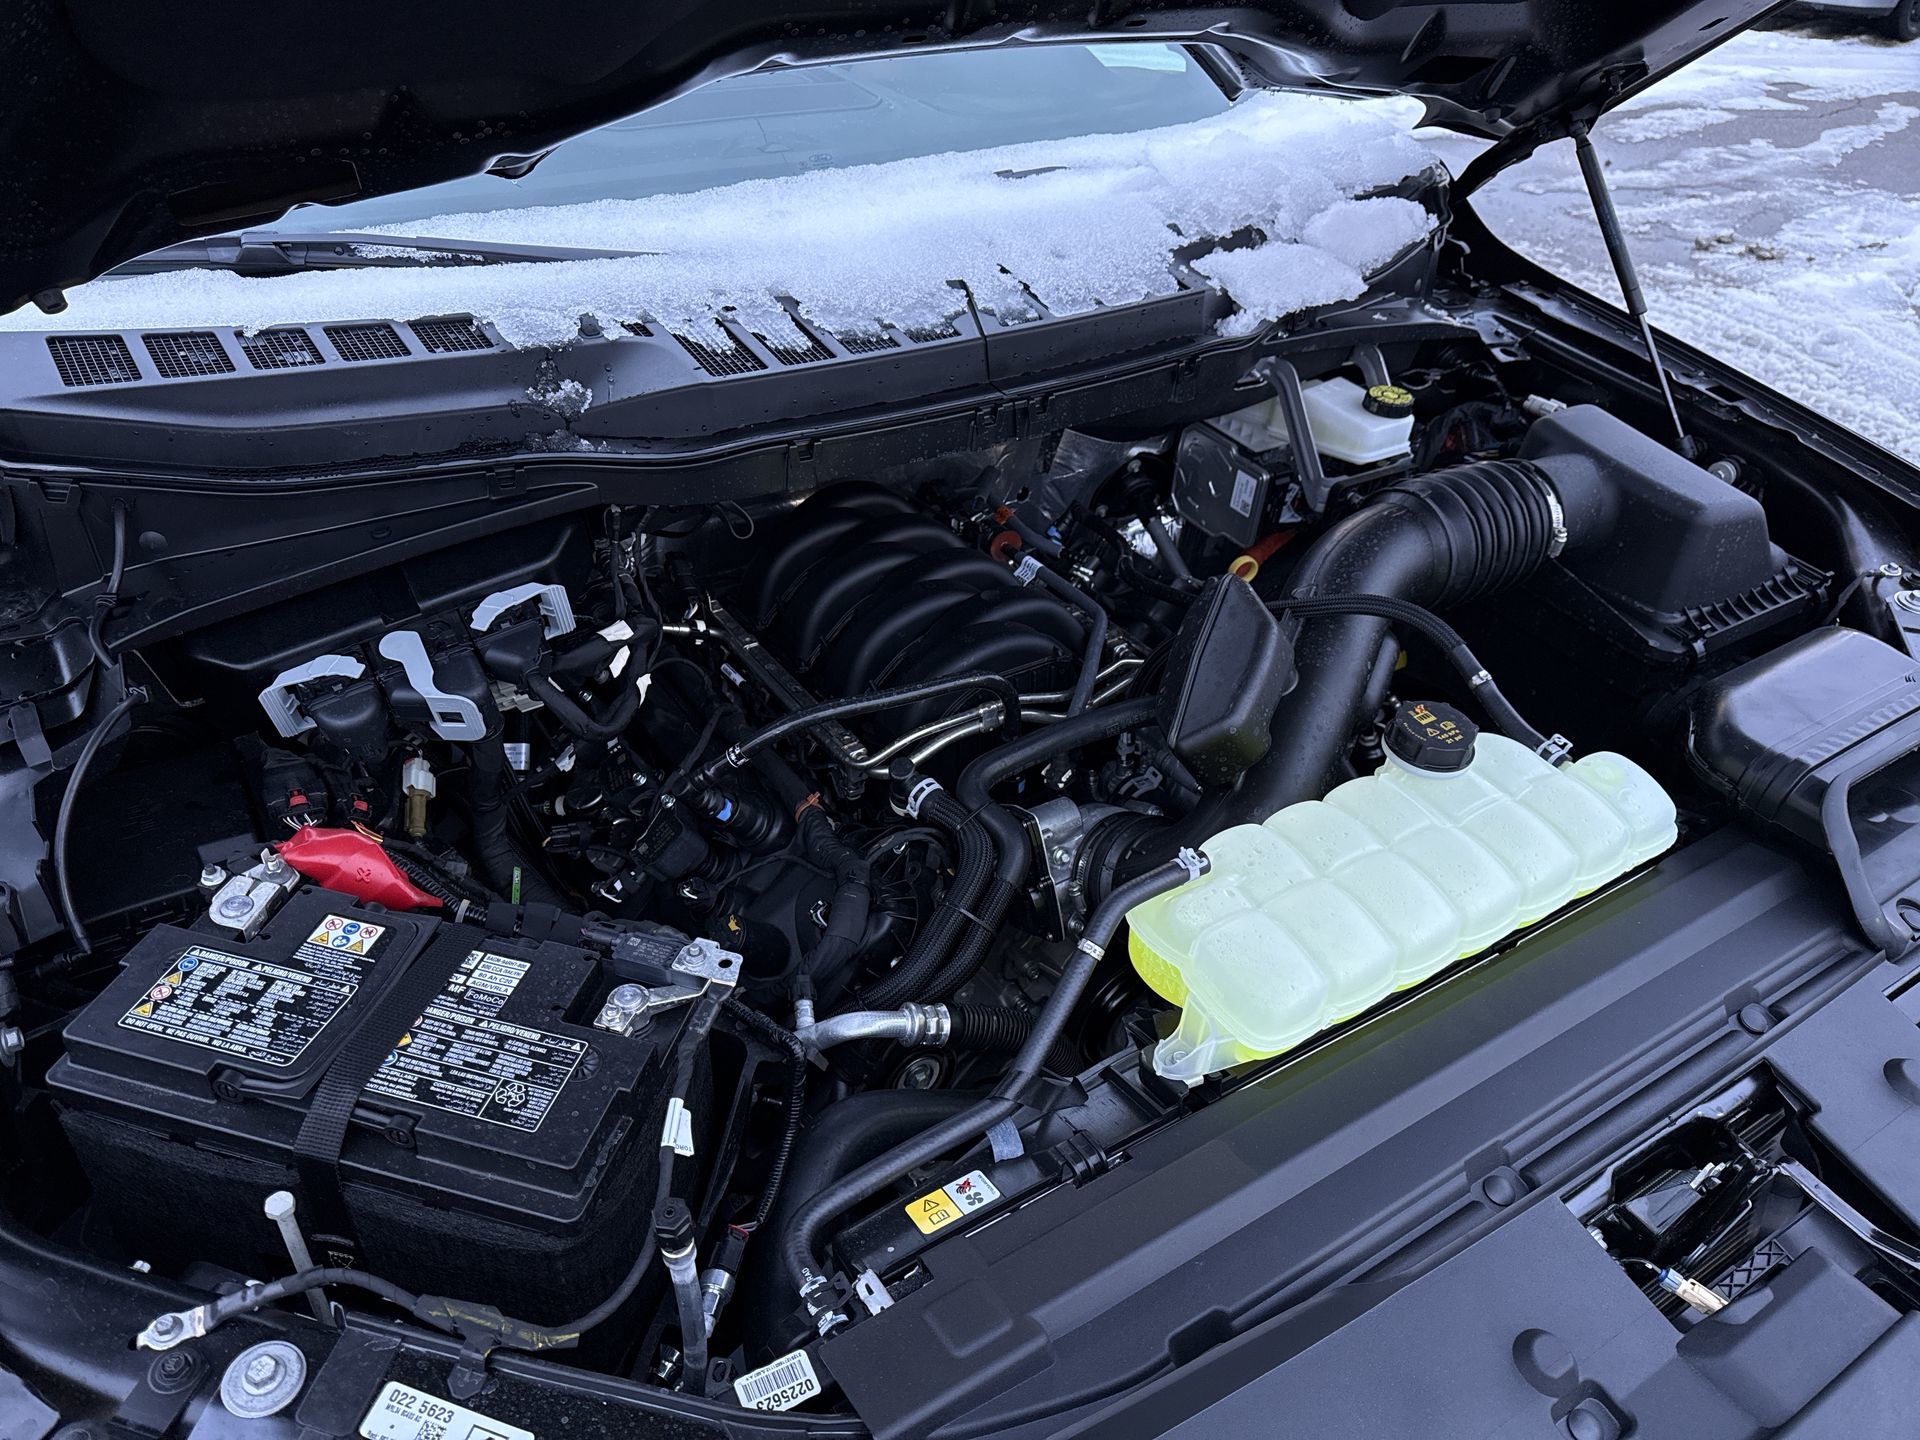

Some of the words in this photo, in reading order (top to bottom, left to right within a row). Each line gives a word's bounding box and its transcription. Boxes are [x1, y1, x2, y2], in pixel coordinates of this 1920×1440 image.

[448, 984, 466, 993] MF
[471, 981, 508, 992] AGM/VRLA
[468, 991, 503, 1004] FoMoCo
[489, 1023, 540, 1040] PELIGRO/VENENO
[802, 1268, 814, 1282] RAD
[756, 1379, 814, 1410] 0225623
[389, 1389, 418, 1410] 022
[418, 1399, 454, 1424] 5623
